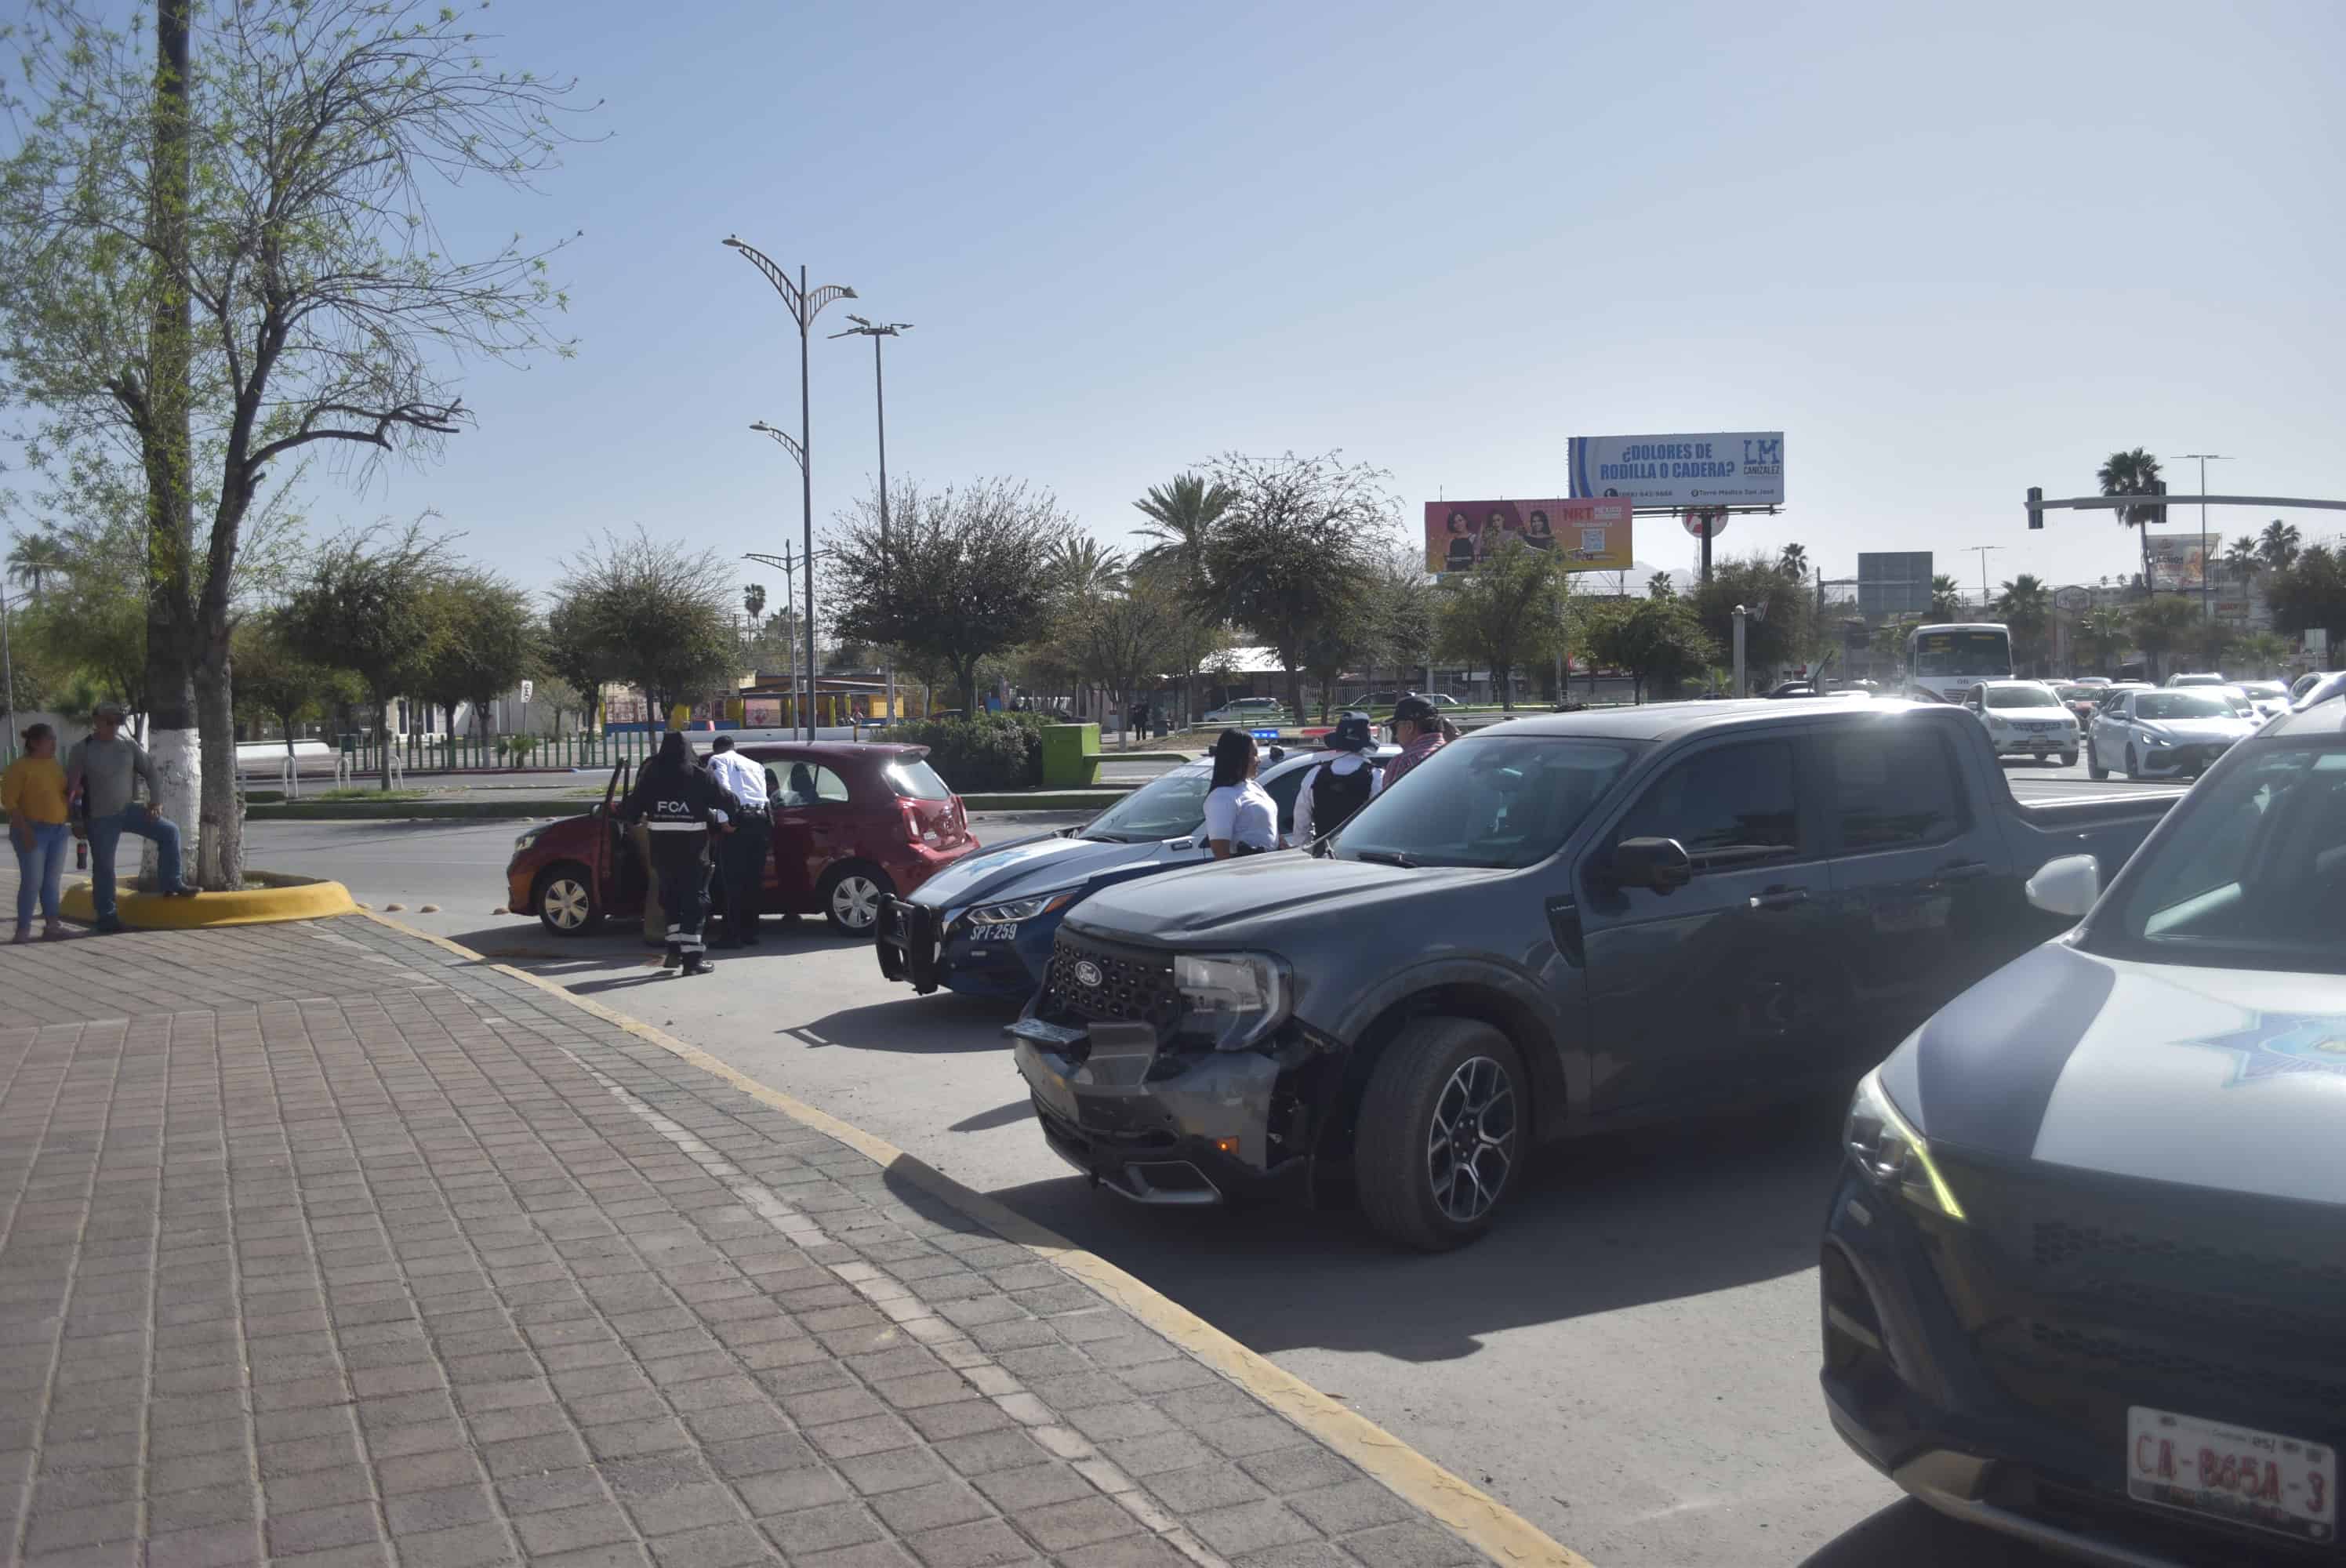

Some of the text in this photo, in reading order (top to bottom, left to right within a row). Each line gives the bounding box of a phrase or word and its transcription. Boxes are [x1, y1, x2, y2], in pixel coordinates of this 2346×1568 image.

[1622, 443, 1712, 463] ¿DOLORES DE
[1743, 440, 1780, 464] LM
[1600, 461, 1734, 480] RODILLA O CADERA?
[657, 801, 690, 813] FCA
[970, 924, 1018, 940] SPT-259
